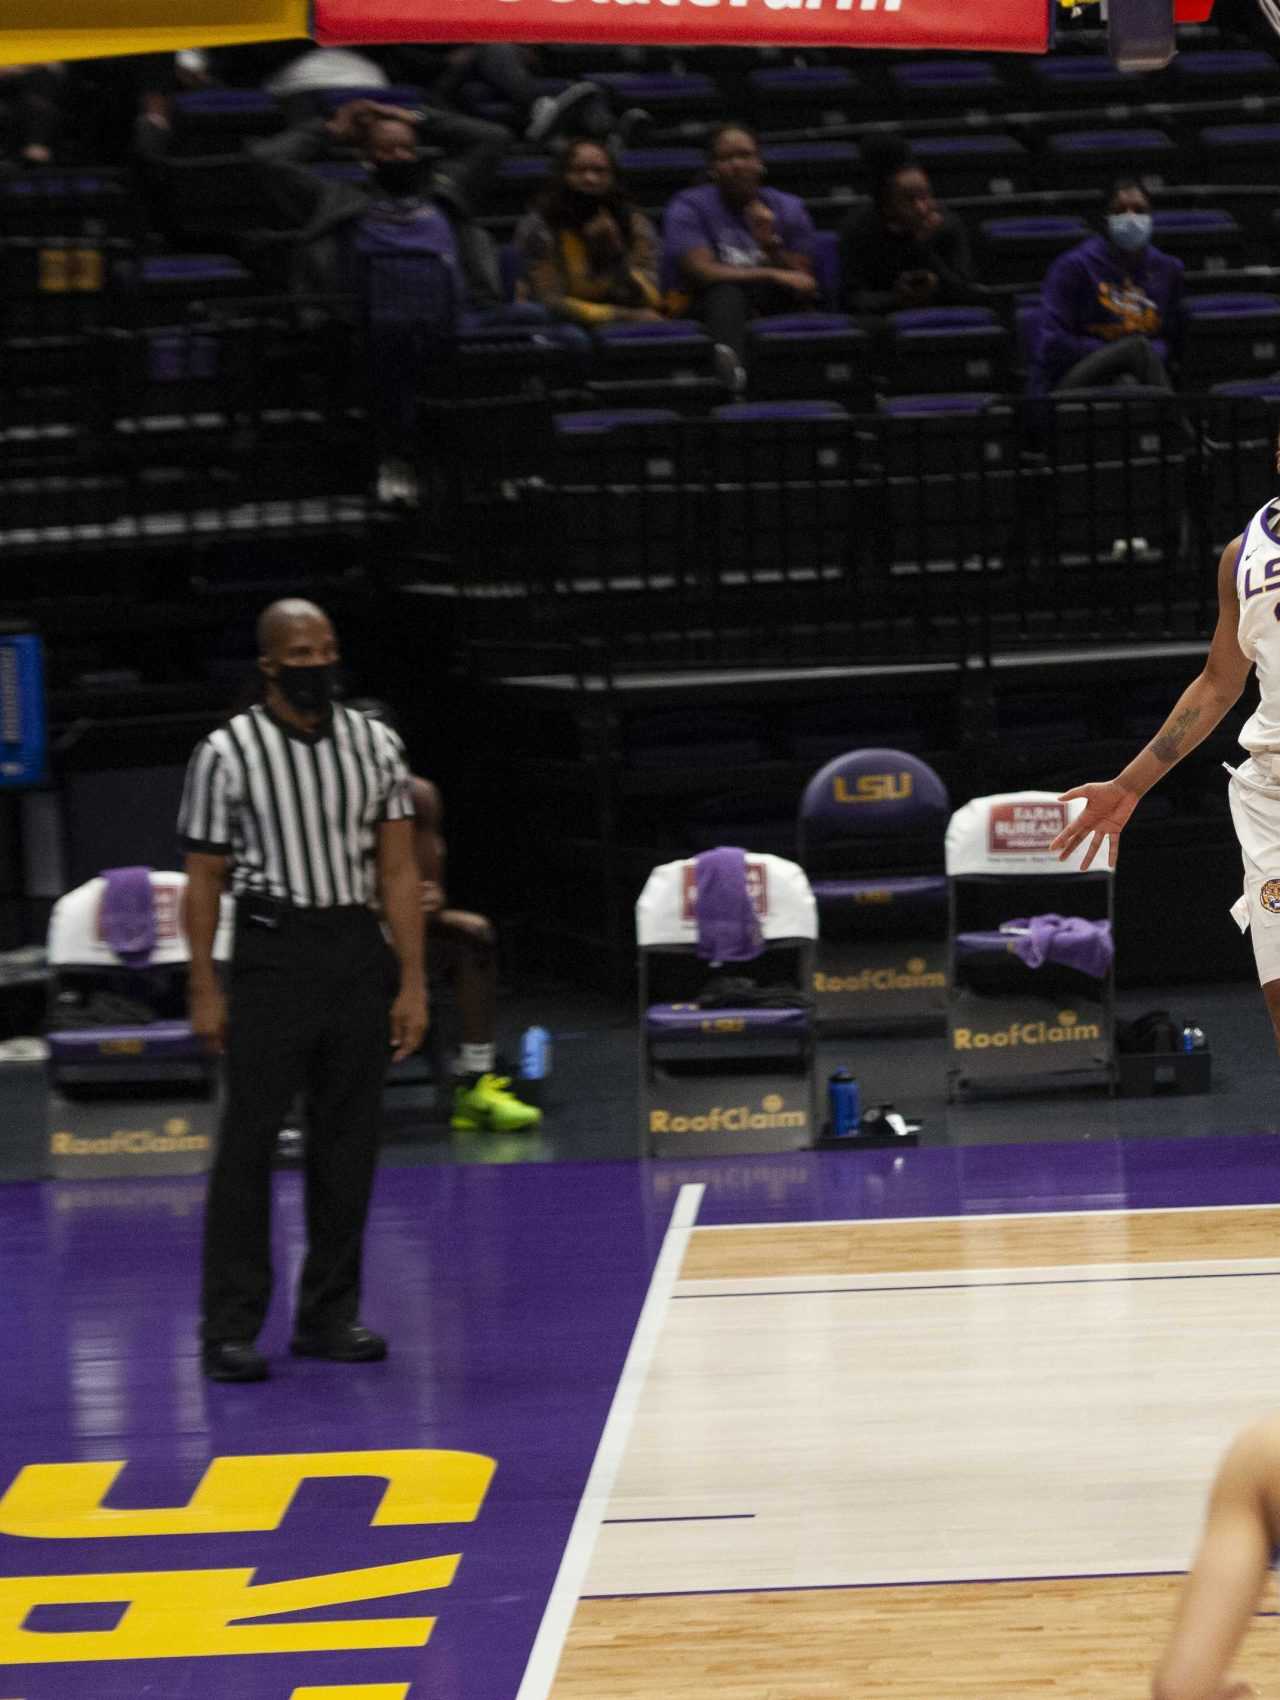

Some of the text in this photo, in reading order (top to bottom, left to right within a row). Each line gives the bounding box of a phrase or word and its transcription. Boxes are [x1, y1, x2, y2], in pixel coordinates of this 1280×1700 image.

[833, 771, 913, 804] LSU
[953, 1009, 1101, 1050] RoofClaim
[650, 1093, 806, 1133] RoofClaim
